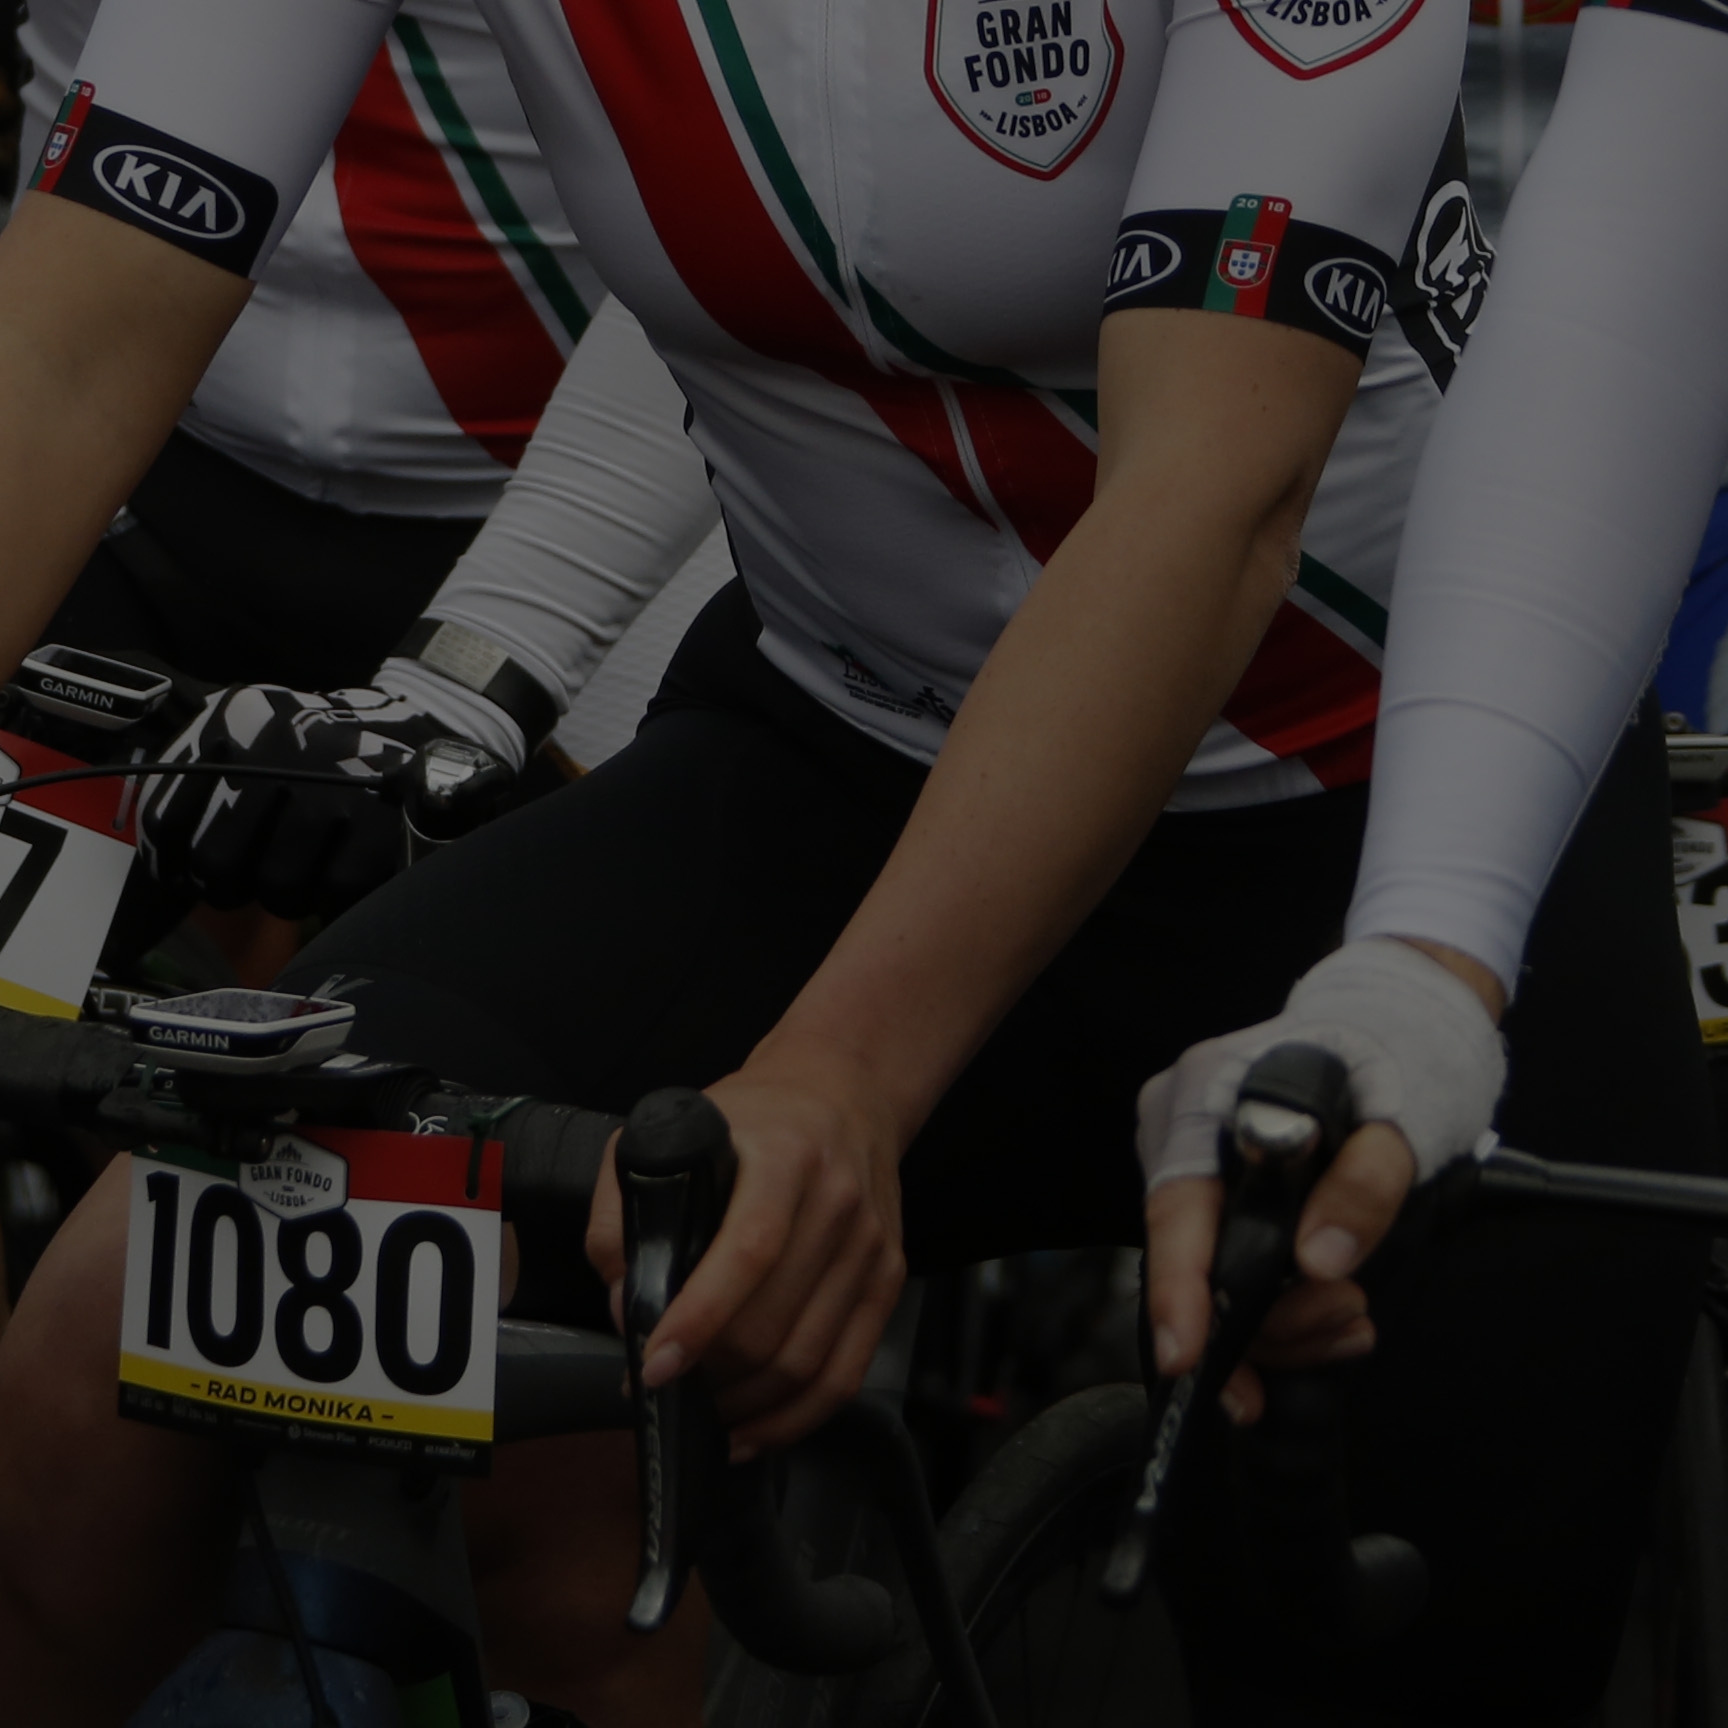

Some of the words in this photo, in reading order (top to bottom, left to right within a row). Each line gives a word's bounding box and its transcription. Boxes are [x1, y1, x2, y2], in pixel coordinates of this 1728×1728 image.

[977, 1, 1072, 49] GRAN
[965, 39, 1091, 92] FONDO
[995, 102, 1079, 139] LISBOA
[115, 152, 217, 232] KIA
[1235, 196, 1259, 210] 20
[1267, 200, 1285, 213] 18
[38, 676, 115, 710] GARMIN
[148, 1025, 230, 1051] GARMIN
[251, 1165, 282, 1181] GRAN
[287, 1167, 332, 1192] FONDO
[271, 1191, 307, 1207] LISBOA
[145, 1170, 475, 1395] 1080
[207, 1379, 257, 1404] RAD
[265, 1390, 374, 1423] MONIKA
